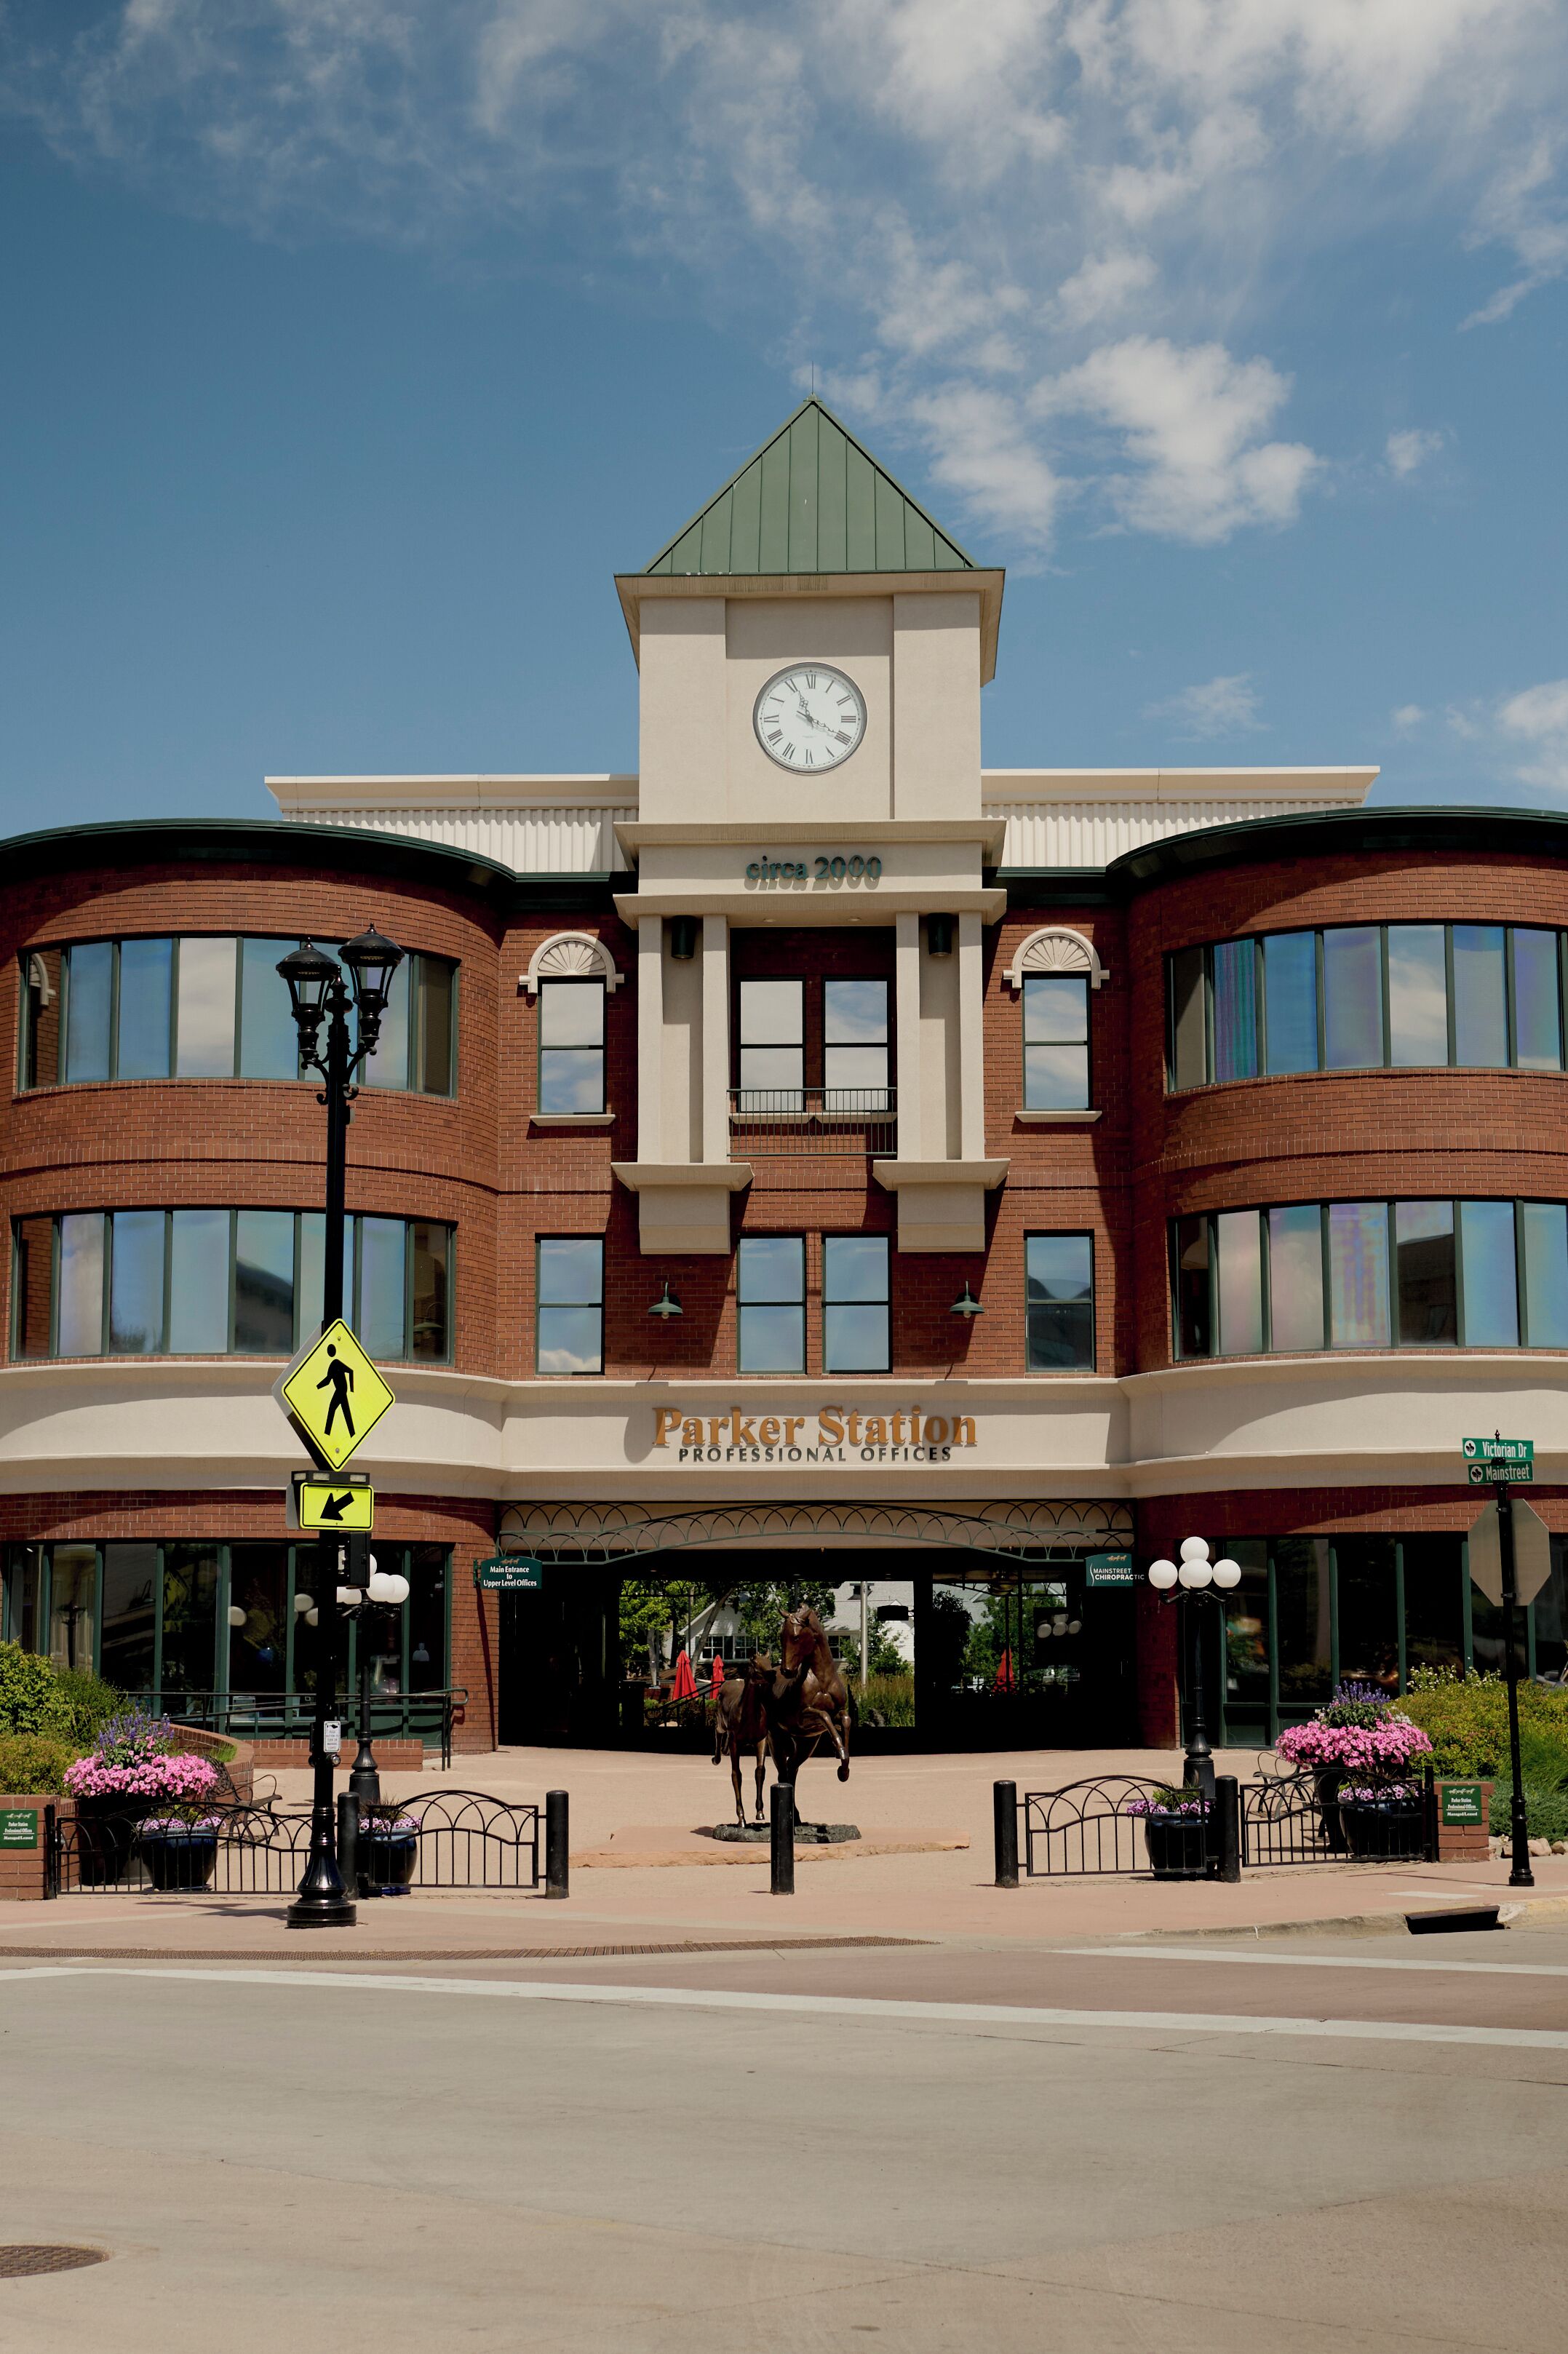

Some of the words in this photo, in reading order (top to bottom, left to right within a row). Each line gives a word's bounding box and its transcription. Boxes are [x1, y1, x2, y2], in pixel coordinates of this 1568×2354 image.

[746, 855, 809, 880] circa
[814, 854, 883, 880] 2000
[652, 1406, 805, 1446] Parker
[819, 1405, 978, 1447] Station
[679, 1448, 846, 1463] PROFESSIONAL
[861, 1447, 951, 1461] OFFICES
[1482, 1442, 1516, 1458] Victorian
[1518, 1443, 1527, 1458] Dr
[1486, 1464, 1529, 1481] Mainstreet
[483, 1580, 501, 1588] Upper
